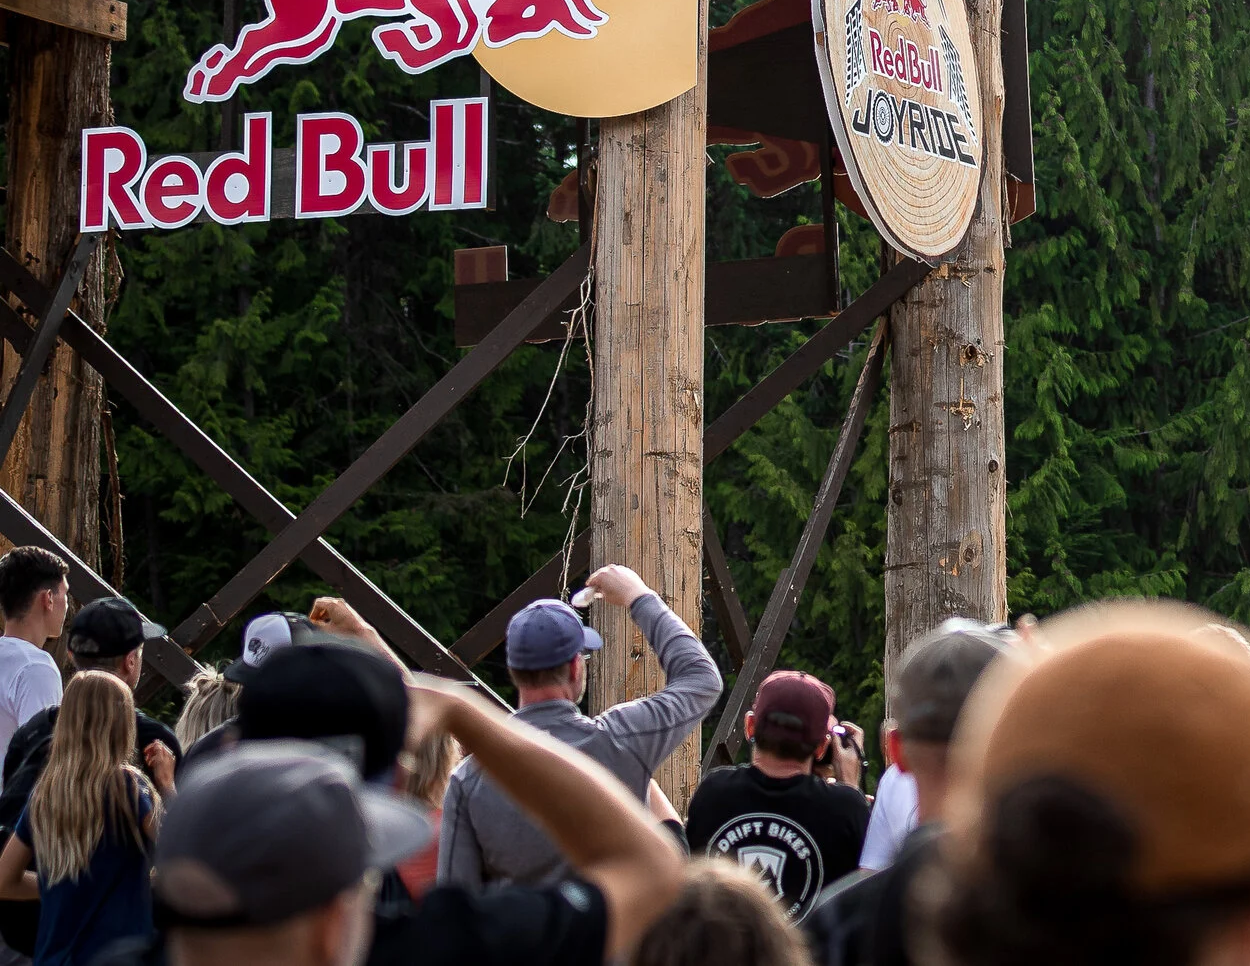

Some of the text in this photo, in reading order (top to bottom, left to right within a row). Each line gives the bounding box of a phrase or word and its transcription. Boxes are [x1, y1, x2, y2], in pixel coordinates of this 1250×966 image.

[869, 29, 943, 93] Red Bull
[852, 87, 977, 166] JOYRIDE
[80, 97, 489, 233] Red Bull
[717, 821, 811, 860] DRIFT BIKES
